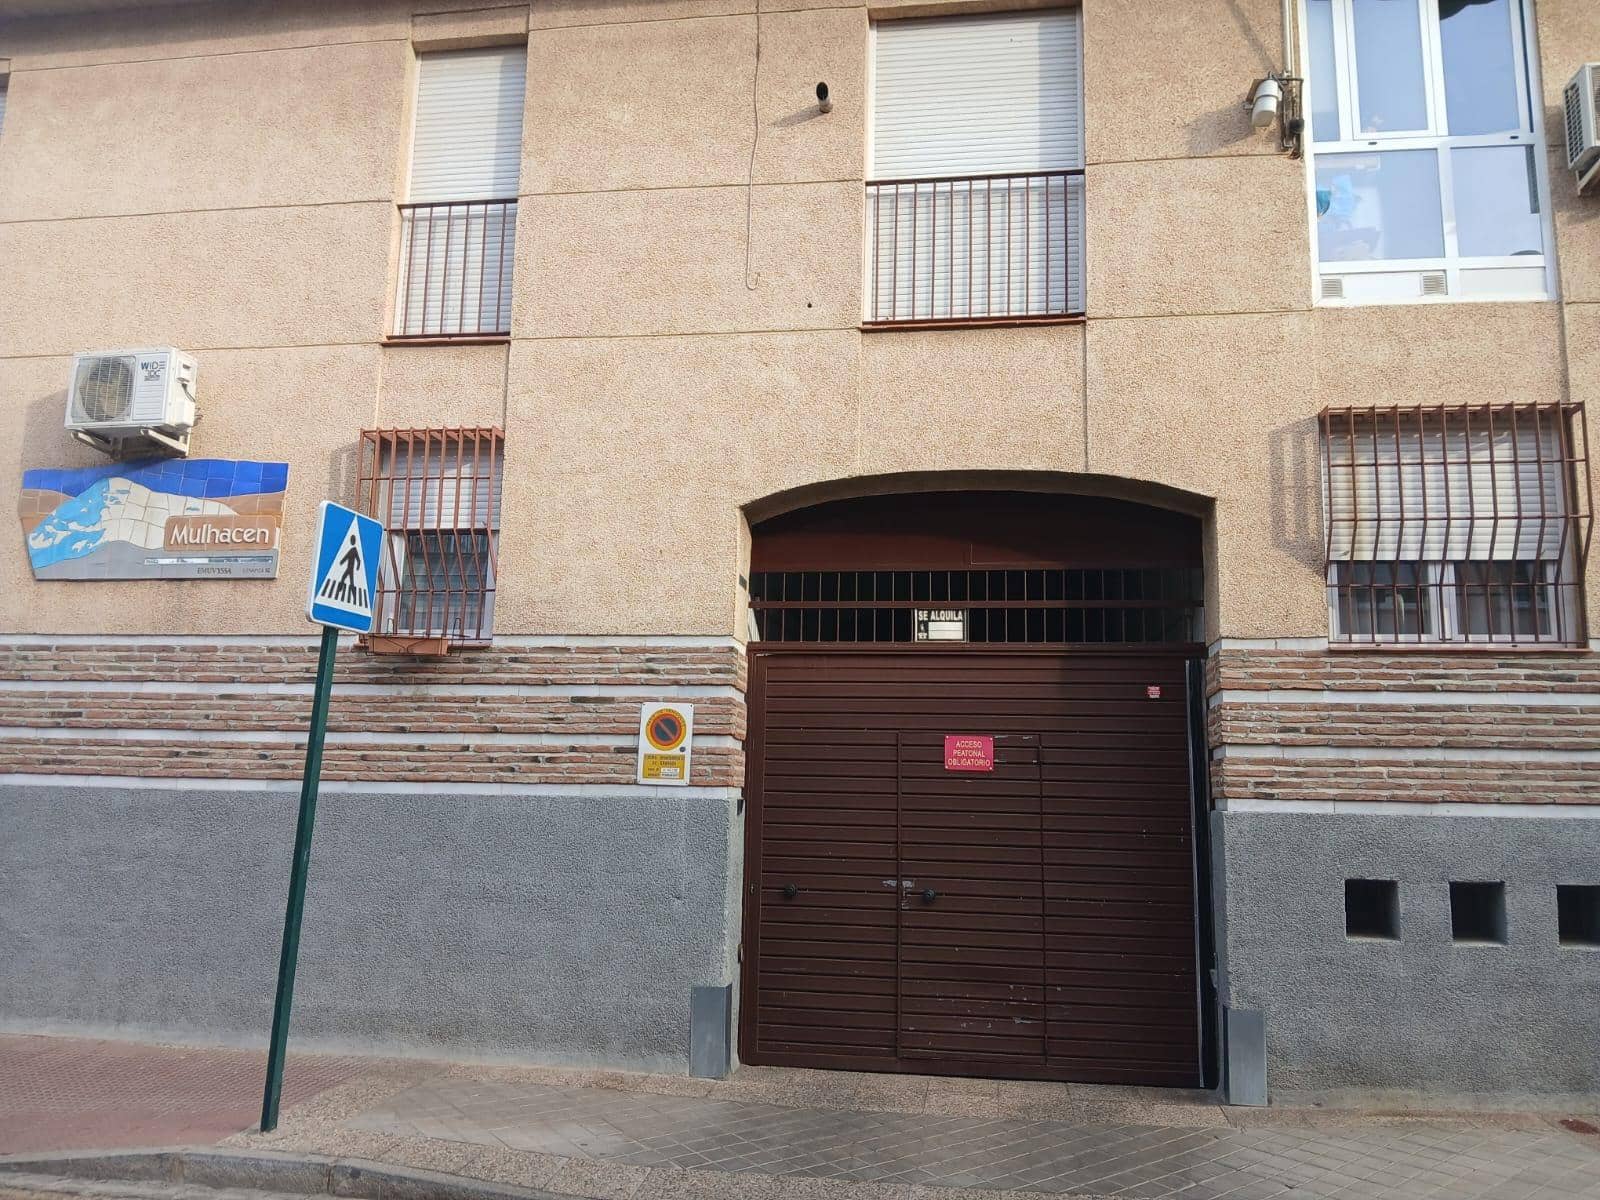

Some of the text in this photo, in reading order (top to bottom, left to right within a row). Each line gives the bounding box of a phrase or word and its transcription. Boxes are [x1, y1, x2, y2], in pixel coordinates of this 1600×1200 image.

[170, 523, 270, 545] Mulhacen
[918, 610, 963, 621] SE ALQUILA
[955, 740, 983, 748] ACCESO
[952, 749, 986, 758] PEATONAL
[947, 758, 991, 767] OBLIGATORIO
